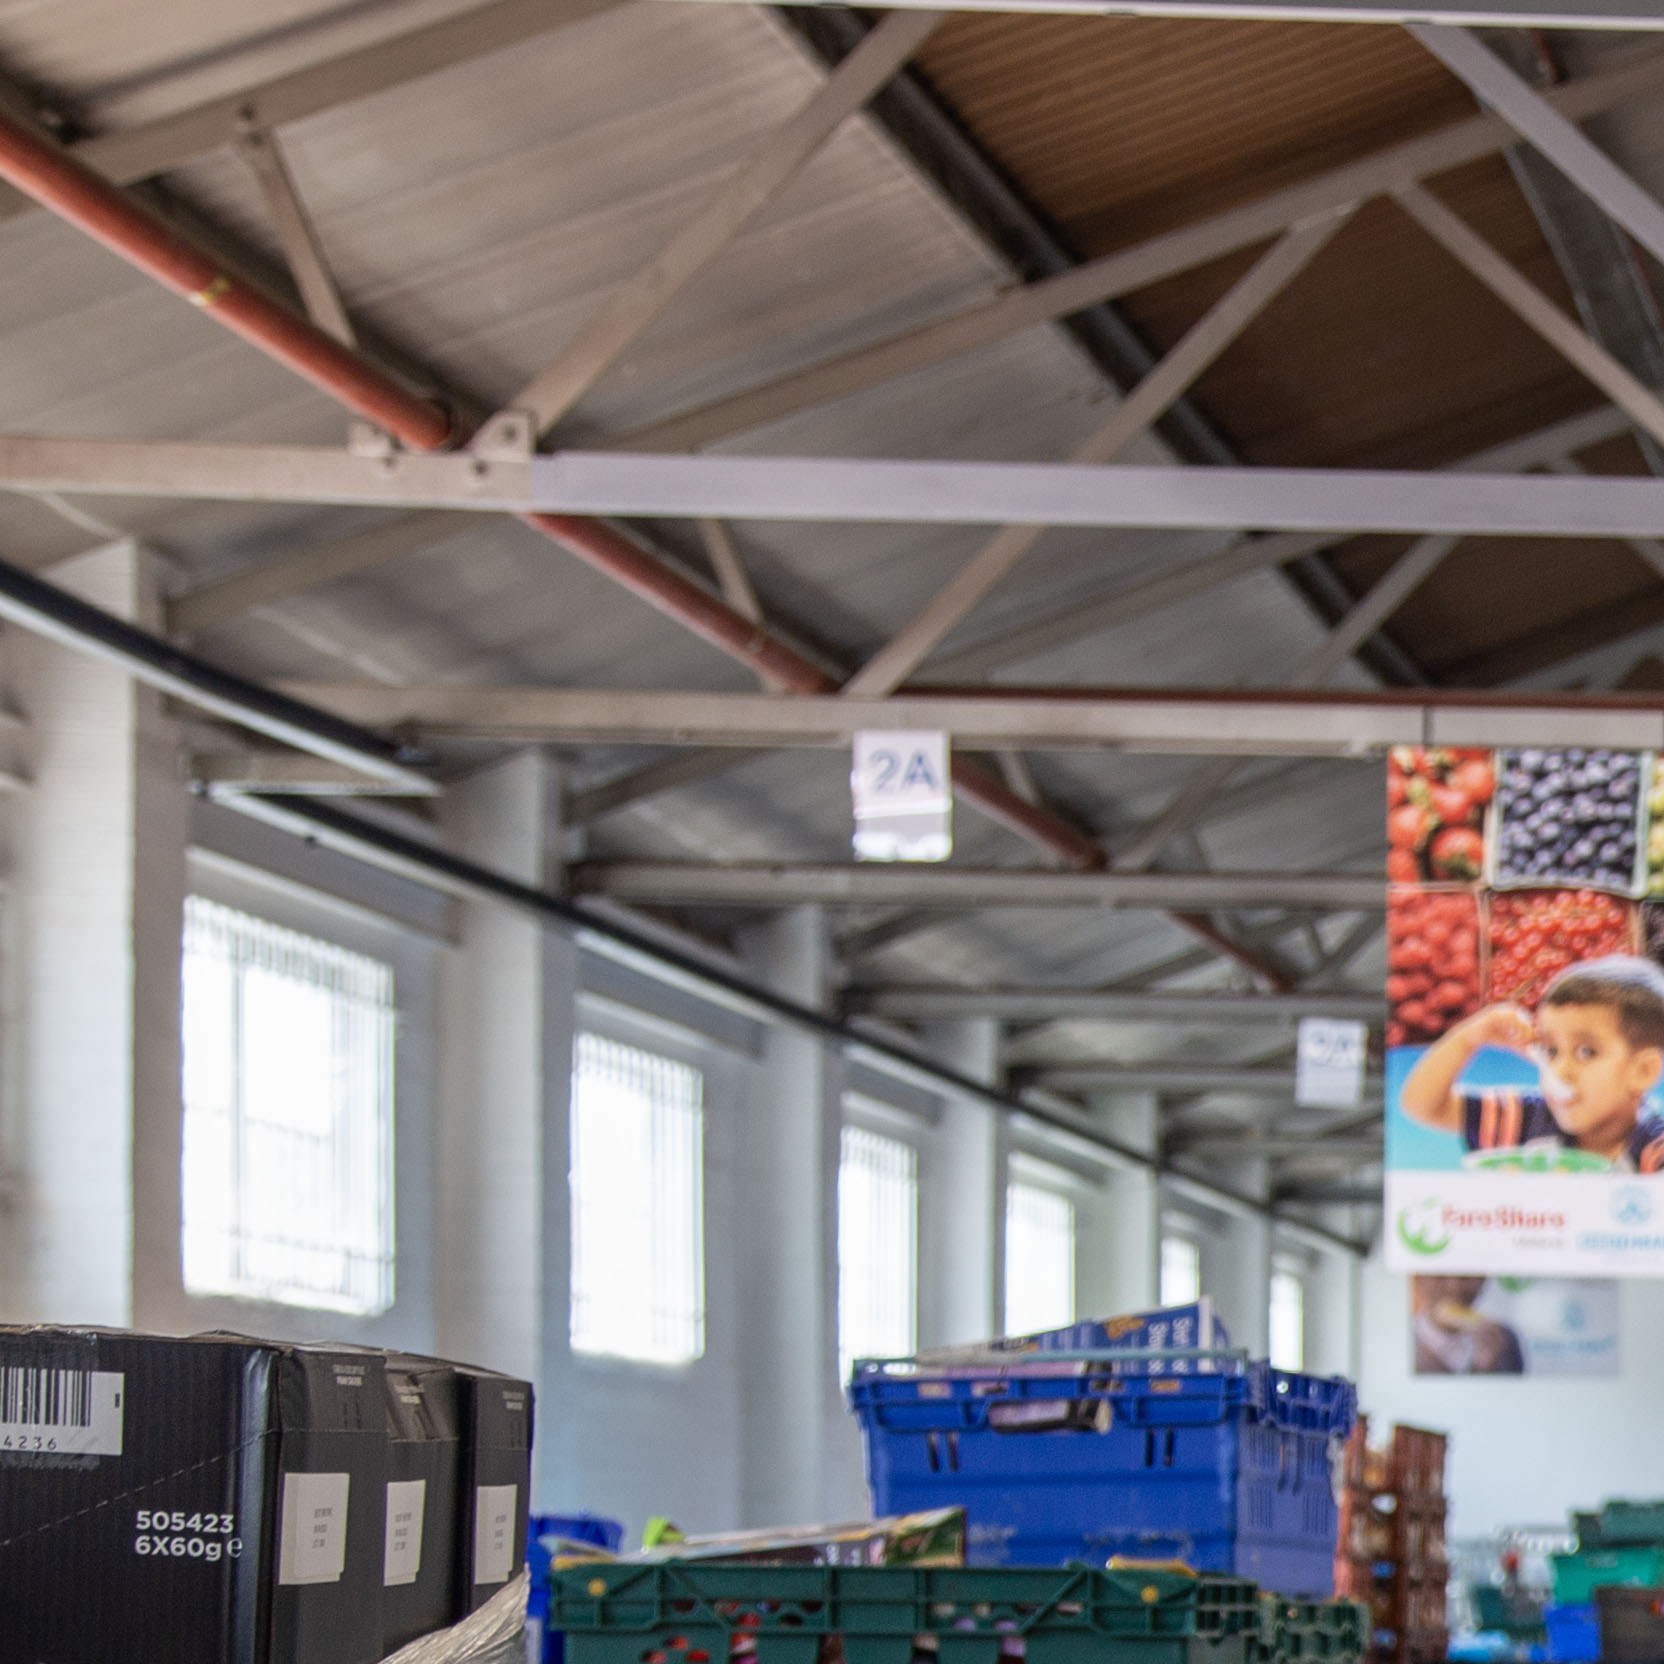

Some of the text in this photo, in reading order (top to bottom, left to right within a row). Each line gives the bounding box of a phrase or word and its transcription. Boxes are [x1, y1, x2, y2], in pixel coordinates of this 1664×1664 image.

[868, 750, 937, 793] 2A
[136, 1510, 234, 1533] 505423
[134, 1535, 222, 1561] 6X60g
